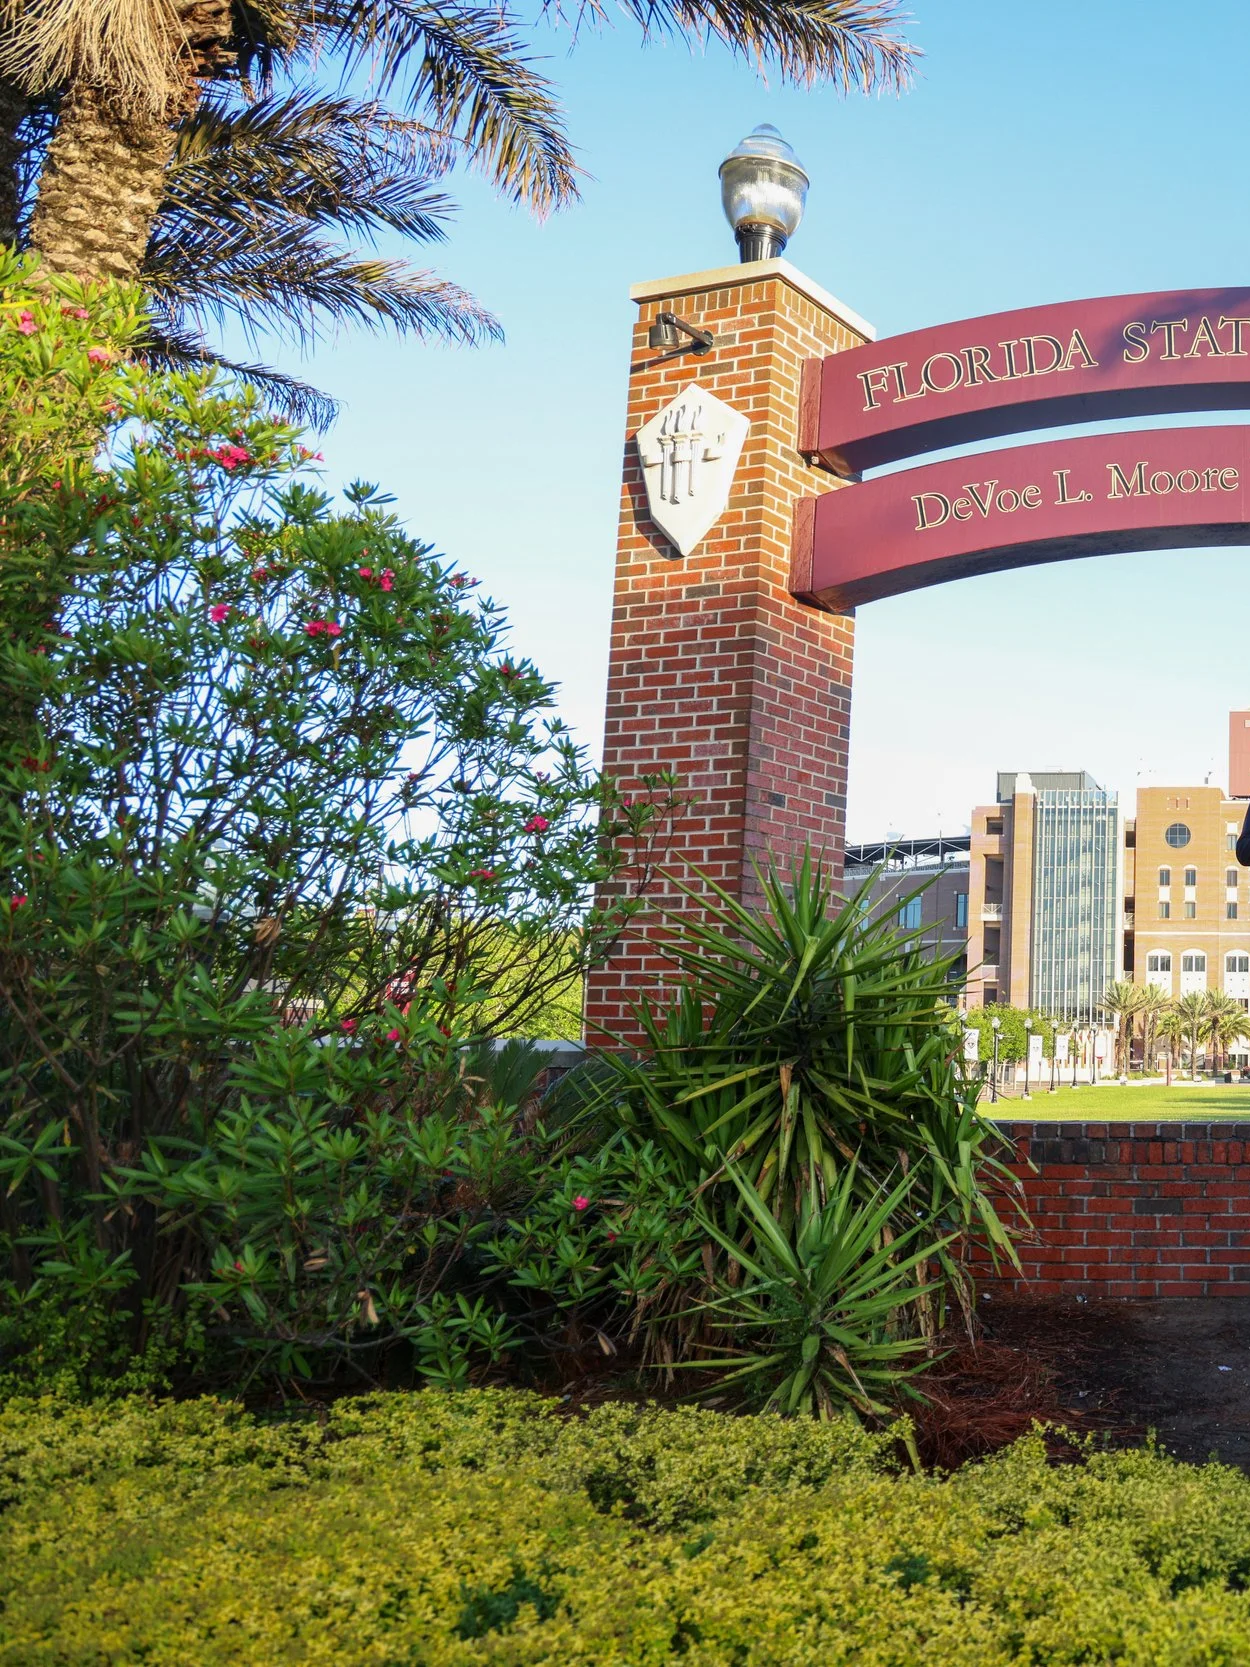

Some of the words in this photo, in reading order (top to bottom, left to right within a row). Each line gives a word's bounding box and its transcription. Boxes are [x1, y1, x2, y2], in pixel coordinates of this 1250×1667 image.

[857, 329, 1098, 411] FLORIDA
[911, 479, 1042, 531] DeVoe
[1053, 469, 1093, 505] L.
[1106, 461, 1239, 499] Moore
